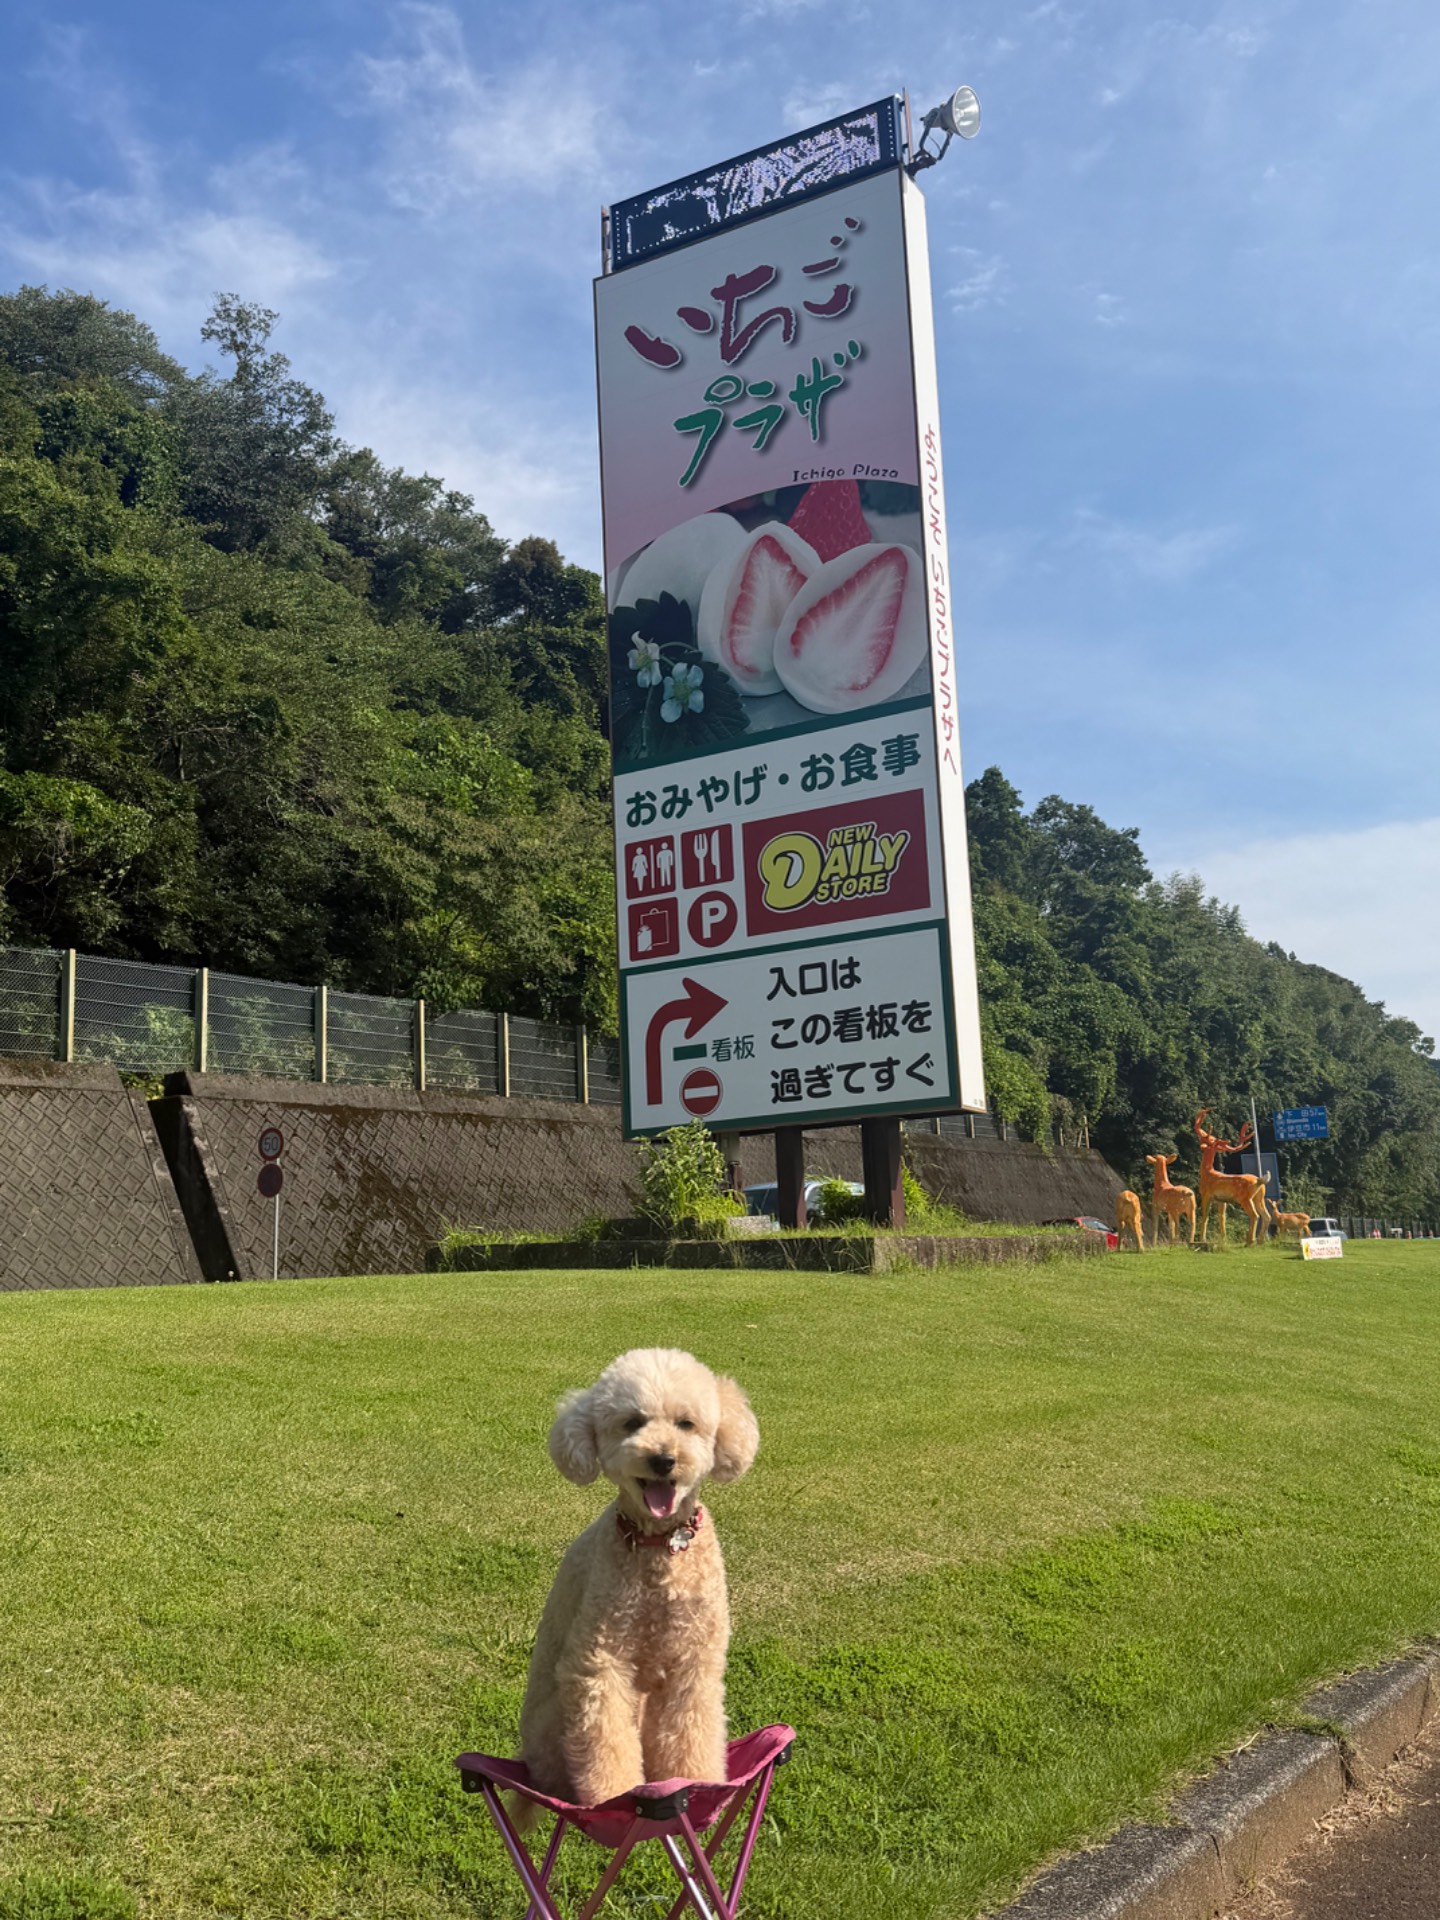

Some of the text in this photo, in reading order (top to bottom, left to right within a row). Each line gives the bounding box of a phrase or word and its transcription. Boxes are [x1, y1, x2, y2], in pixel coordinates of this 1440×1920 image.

[624, 217, 860, 365] いちご
[674, 340, 861, 487] プラザ
[793, 464, 899, 482] Ichigo Plaza
[924, 424, 958, 775] ようこそ いちごプラザへ
[626, 733, 921, 827] おみやげ・お食事
[830, 824, 873, 846] NEW
[760, 831, 908, 909] DAILY
[816, 872, 888, 901] STORE
[702, 900, 727, 938] P
[767, 956, 862, 1000] 入口は
[770, 1000, 932, 1049] この看板を
[711, 1035, 755, 1062] 看板
[770, 1052, 934, 1104] 過ぎてすぐ
[264, 1136, 279, 1152] 50
